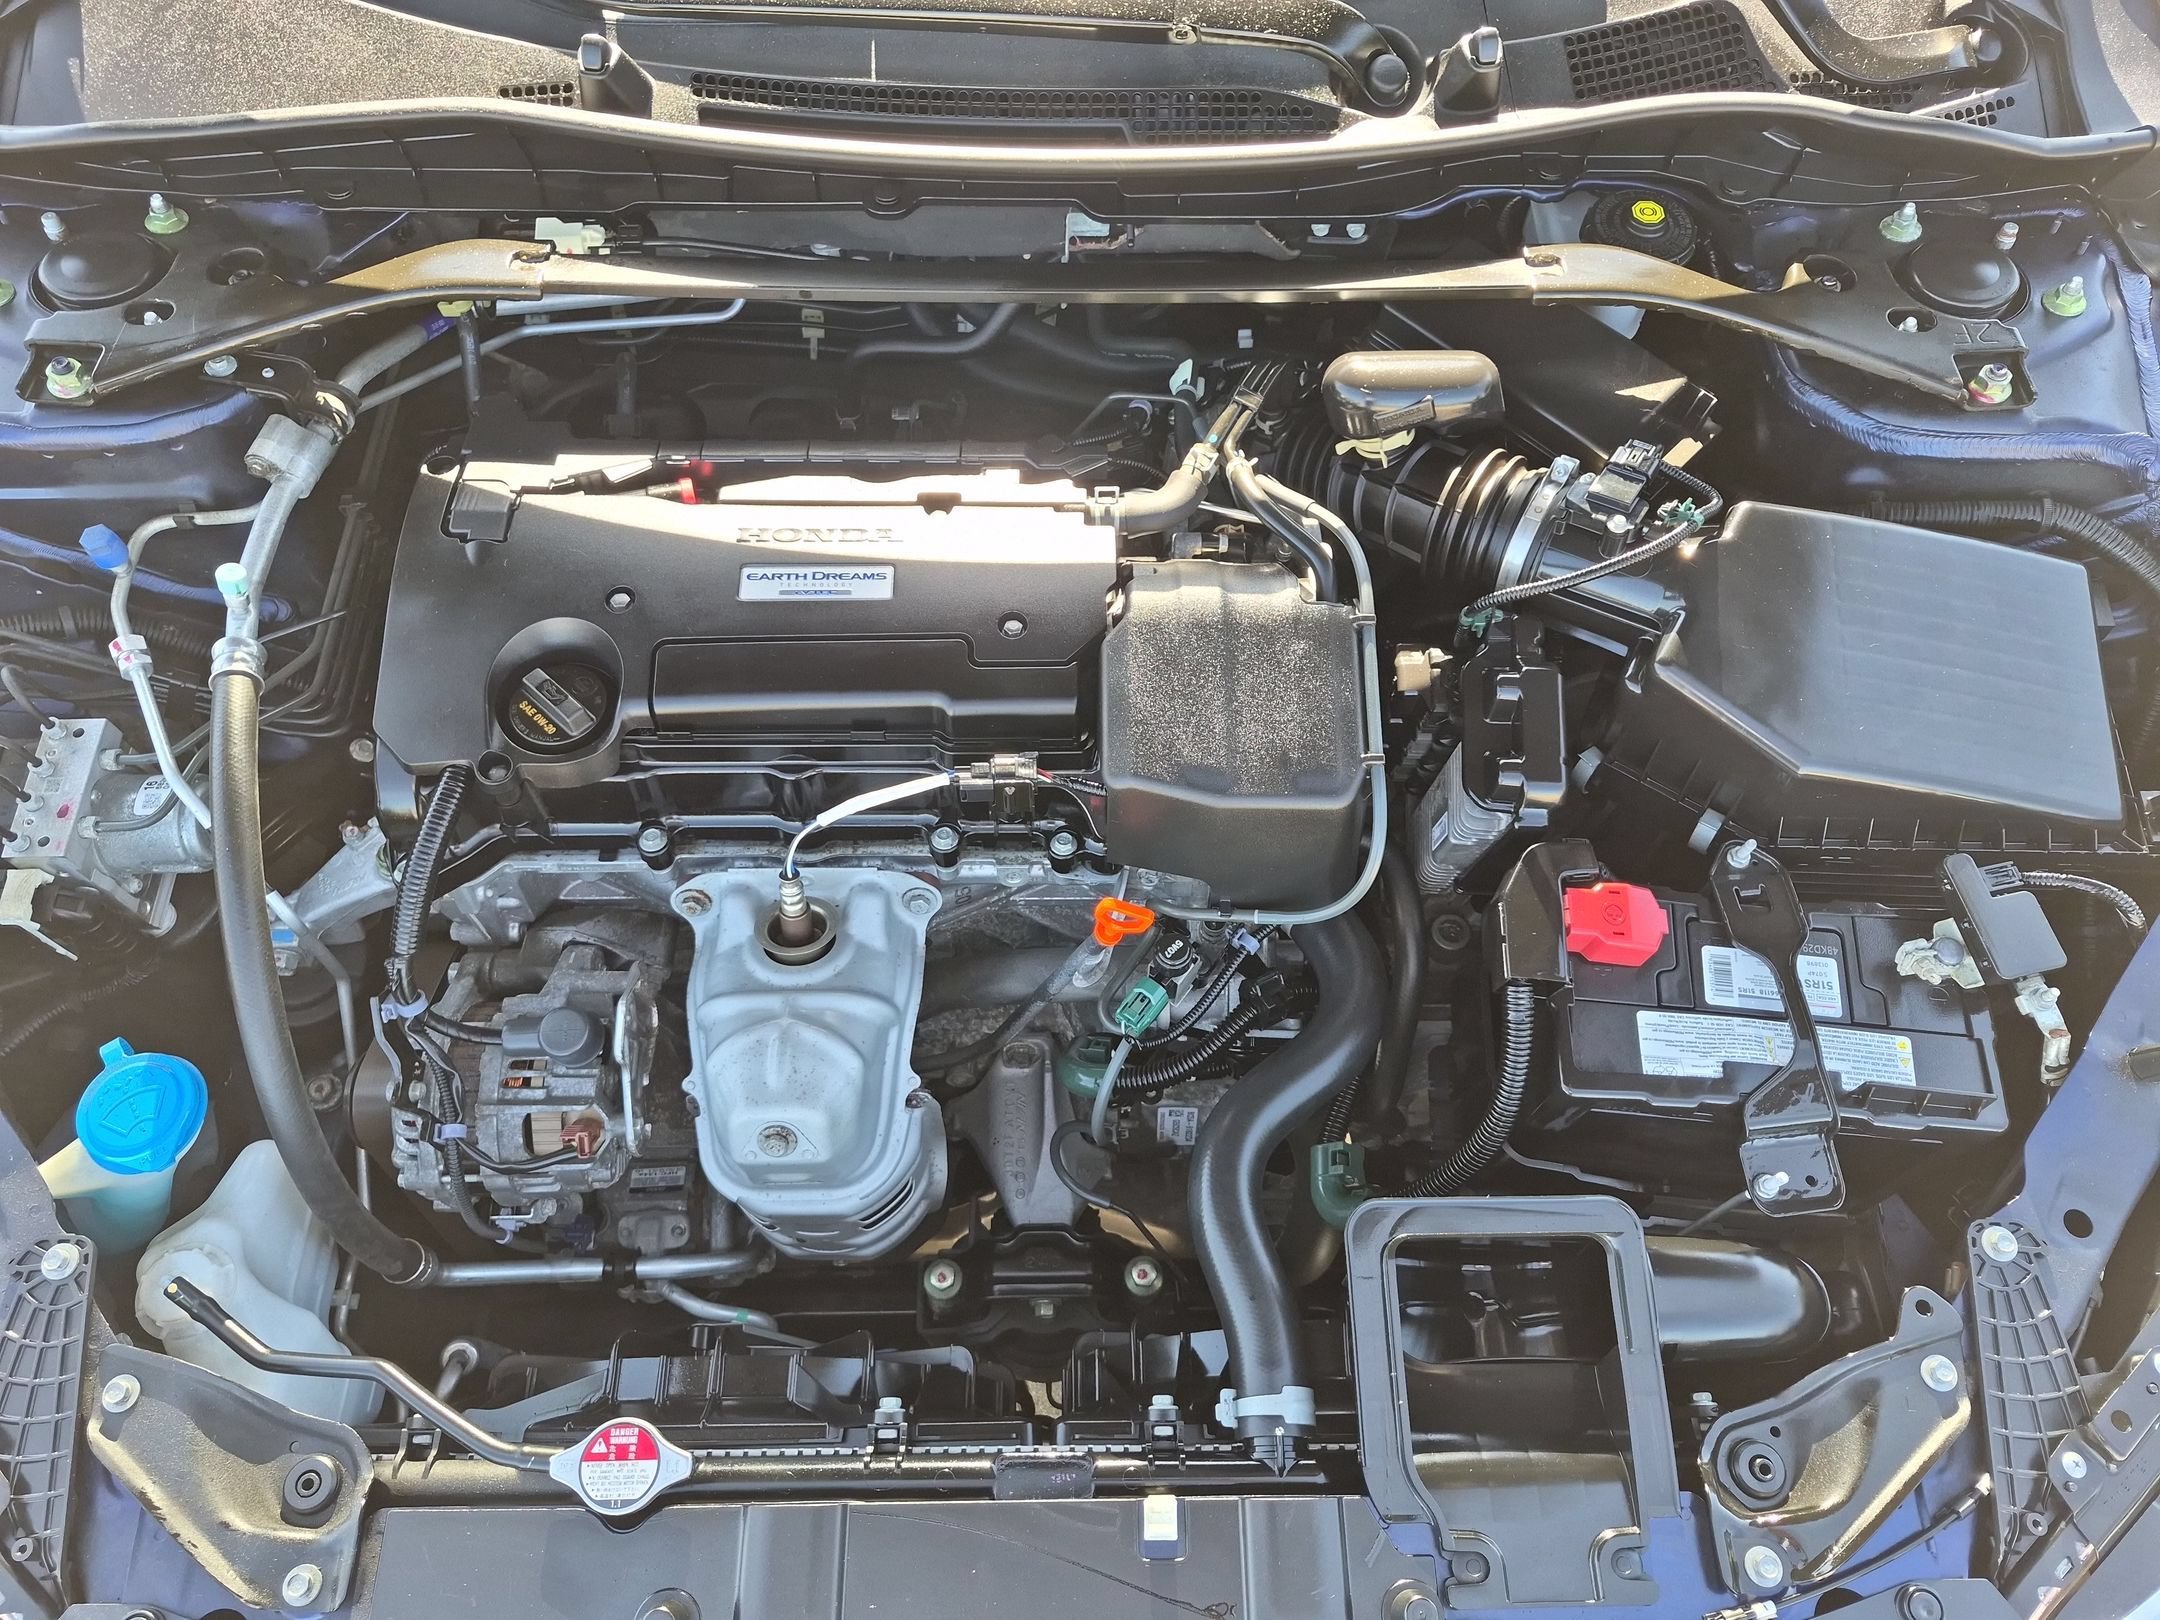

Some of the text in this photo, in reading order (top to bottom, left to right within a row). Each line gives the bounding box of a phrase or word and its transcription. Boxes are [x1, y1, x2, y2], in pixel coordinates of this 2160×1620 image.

[735, 527, 904, 543] HONDA
[746, 571, 888, 581] EARTH DREAMS
[519, 701, 537, 717] SAE
[533, 714, 556, 735] 0W-20
[1804, 978, 1833, 991] 51RS
[611, 1428, 639, 1436] DANGER
[610, 1499, 621, 1508] 1.1
